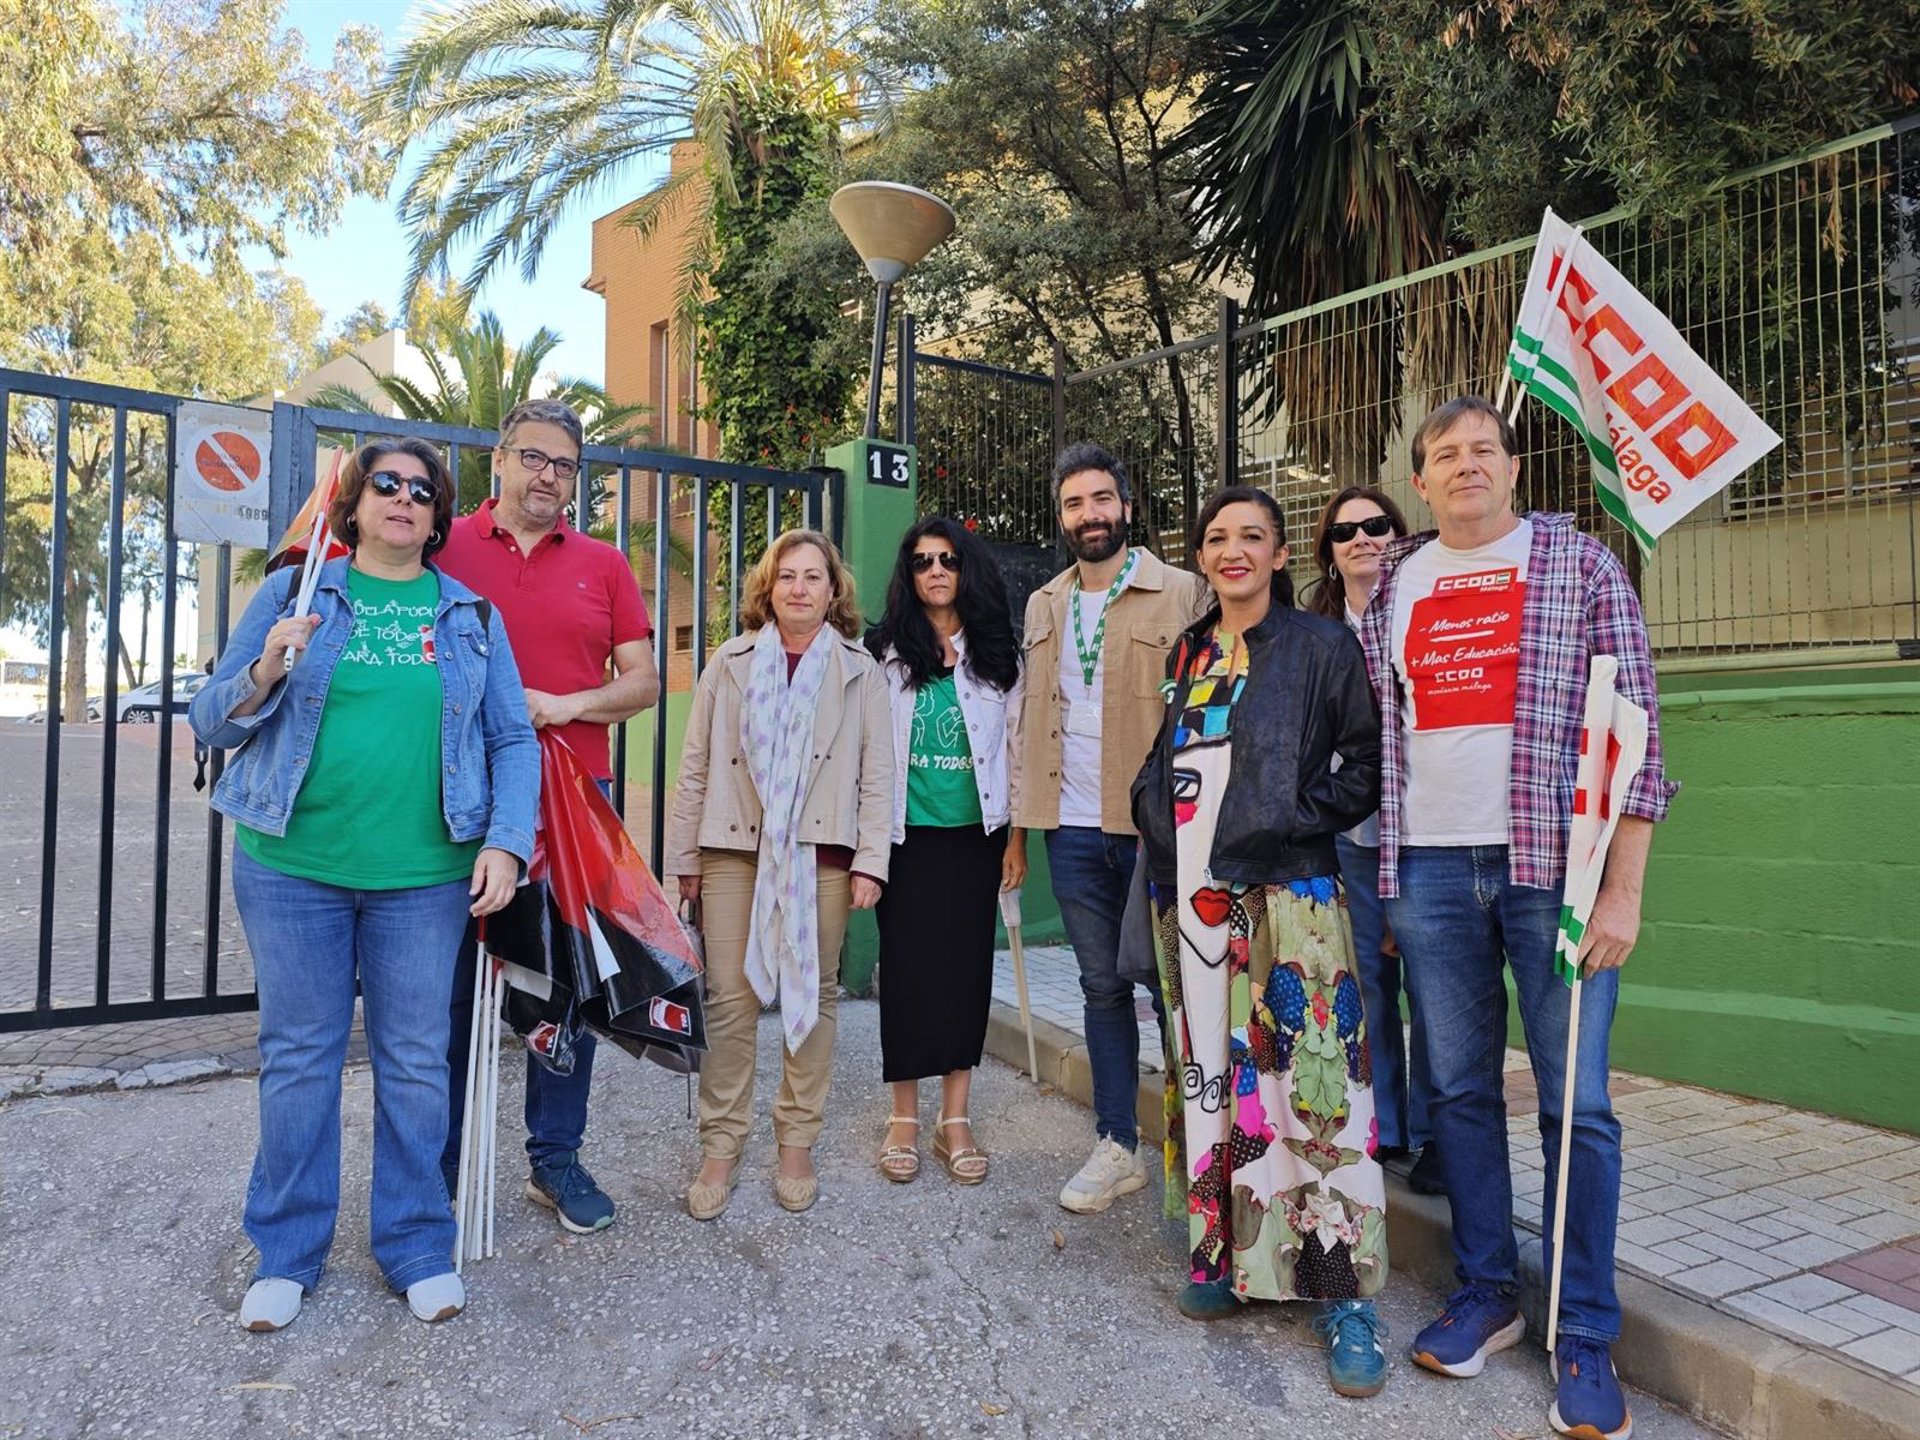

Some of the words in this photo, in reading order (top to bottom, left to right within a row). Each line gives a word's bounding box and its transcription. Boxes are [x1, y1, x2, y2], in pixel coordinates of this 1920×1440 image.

[1546, 253, 1739, 481] CCOO
[870, 450, 909, 482] 13
[1605, 411, 1672, 504] álaga
[1438, 574, 1497, 591] CCOO
[1428, 618, 1473, 634] Menos
[1476, 611, 1510, 625] ratio
[342, 650, 383, 666] ARA
[1420, 650, 1451, 667] Mas
[1453, 642, 1520, 662] Educación
[1435, 667, 1484, 683] CCOO
[910, 753, 929, 768] RA
